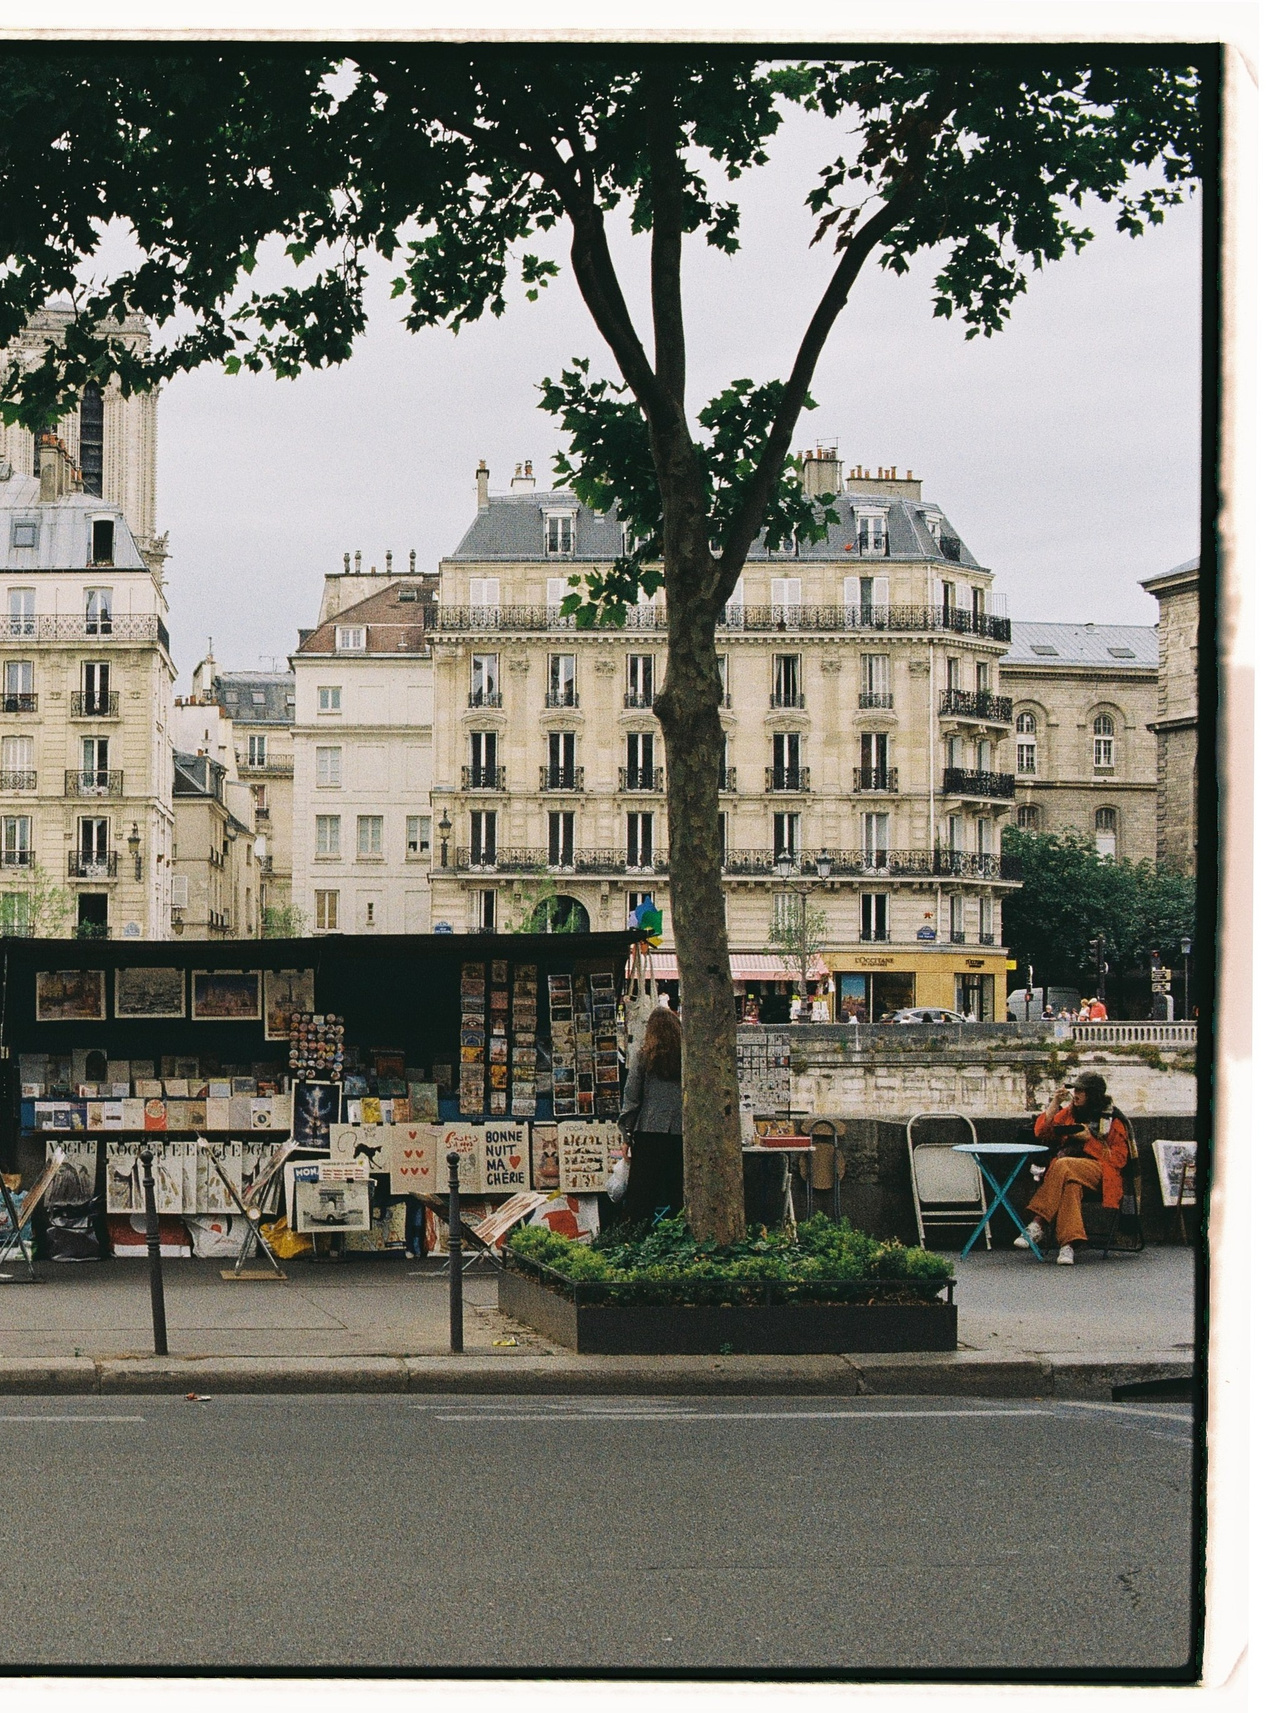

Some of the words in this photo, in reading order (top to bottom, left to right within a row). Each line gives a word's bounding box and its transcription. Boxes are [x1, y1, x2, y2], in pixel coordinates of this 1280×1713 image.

[485, 1130, 523, 1143] BONNE
[48, 1142, 96, 1154] VOGUE
[485, 1144, 516, 1157] NUIT
[486, 1158, 505, 1171] MA
[486, 1168, 525, 1185] CHÉRIE
